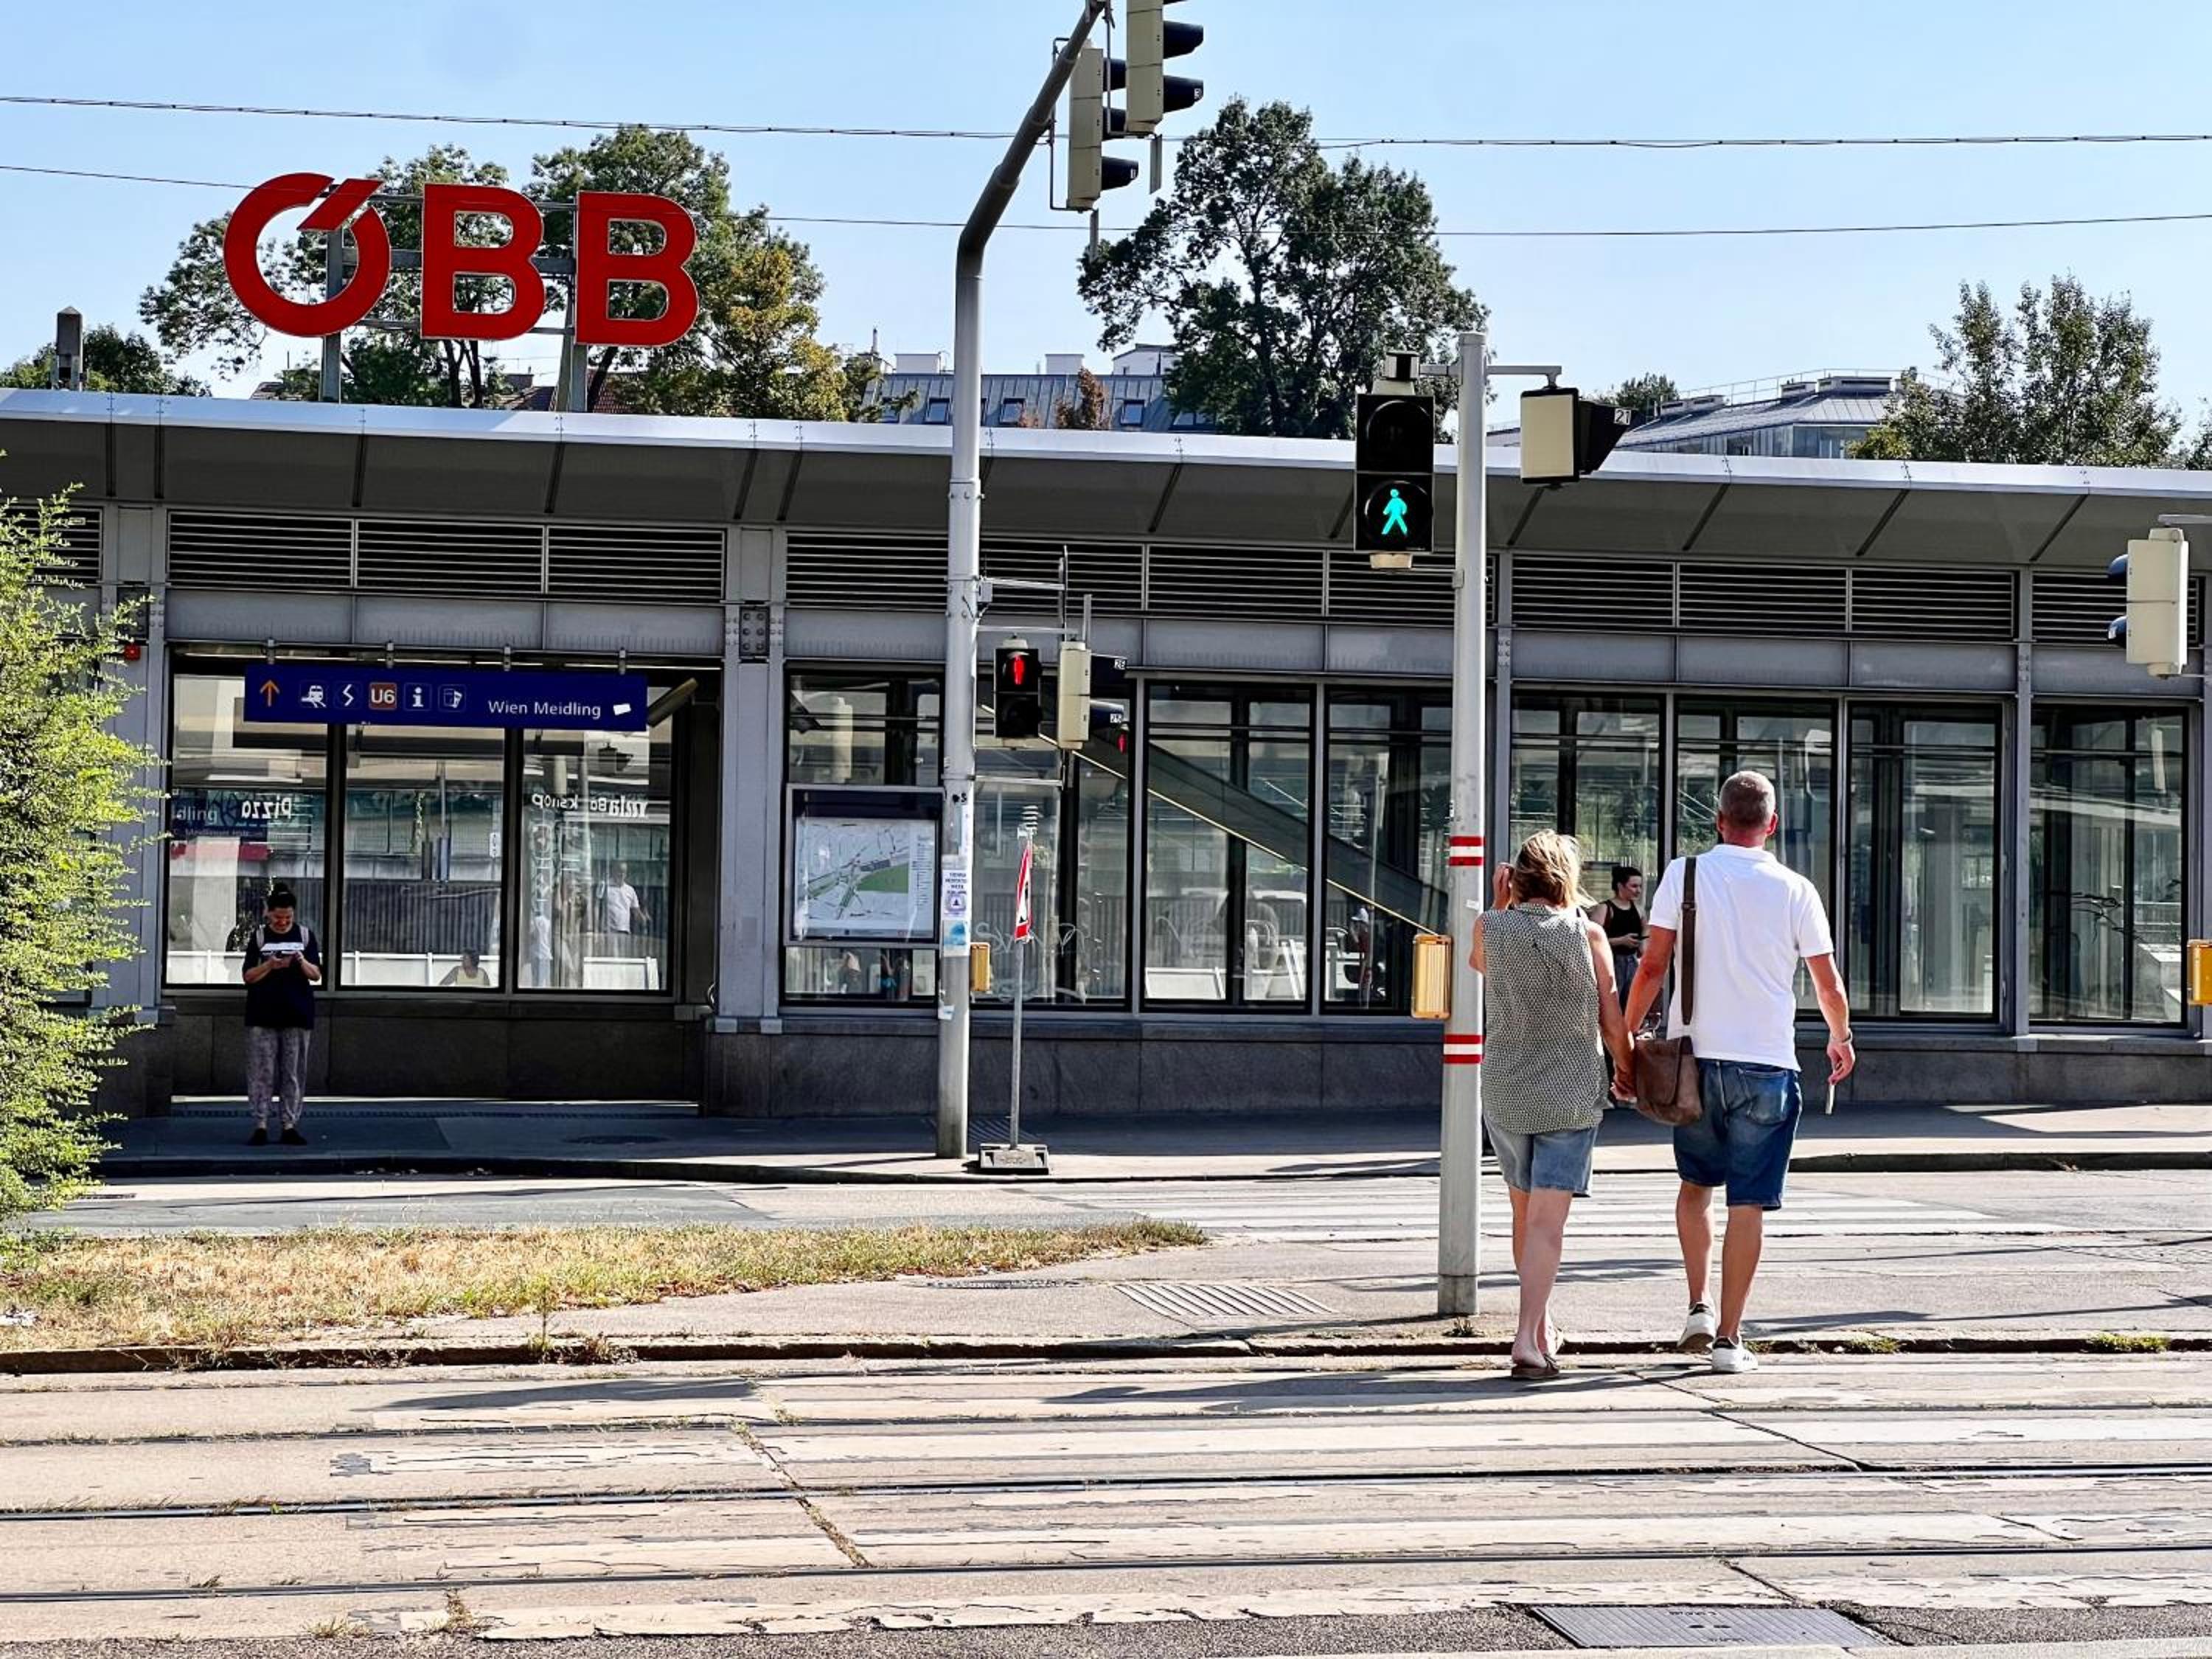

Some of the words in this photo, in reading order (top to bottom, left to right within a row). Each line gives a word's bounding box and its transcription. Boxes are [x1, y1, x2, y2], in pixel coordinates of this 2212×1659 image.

[1615, 409, 1630, 424] 21
[371, 689, 395, 705] U6
[488, 700, 528, 714] Wien
[534, 702, 601, 720] Meidling
